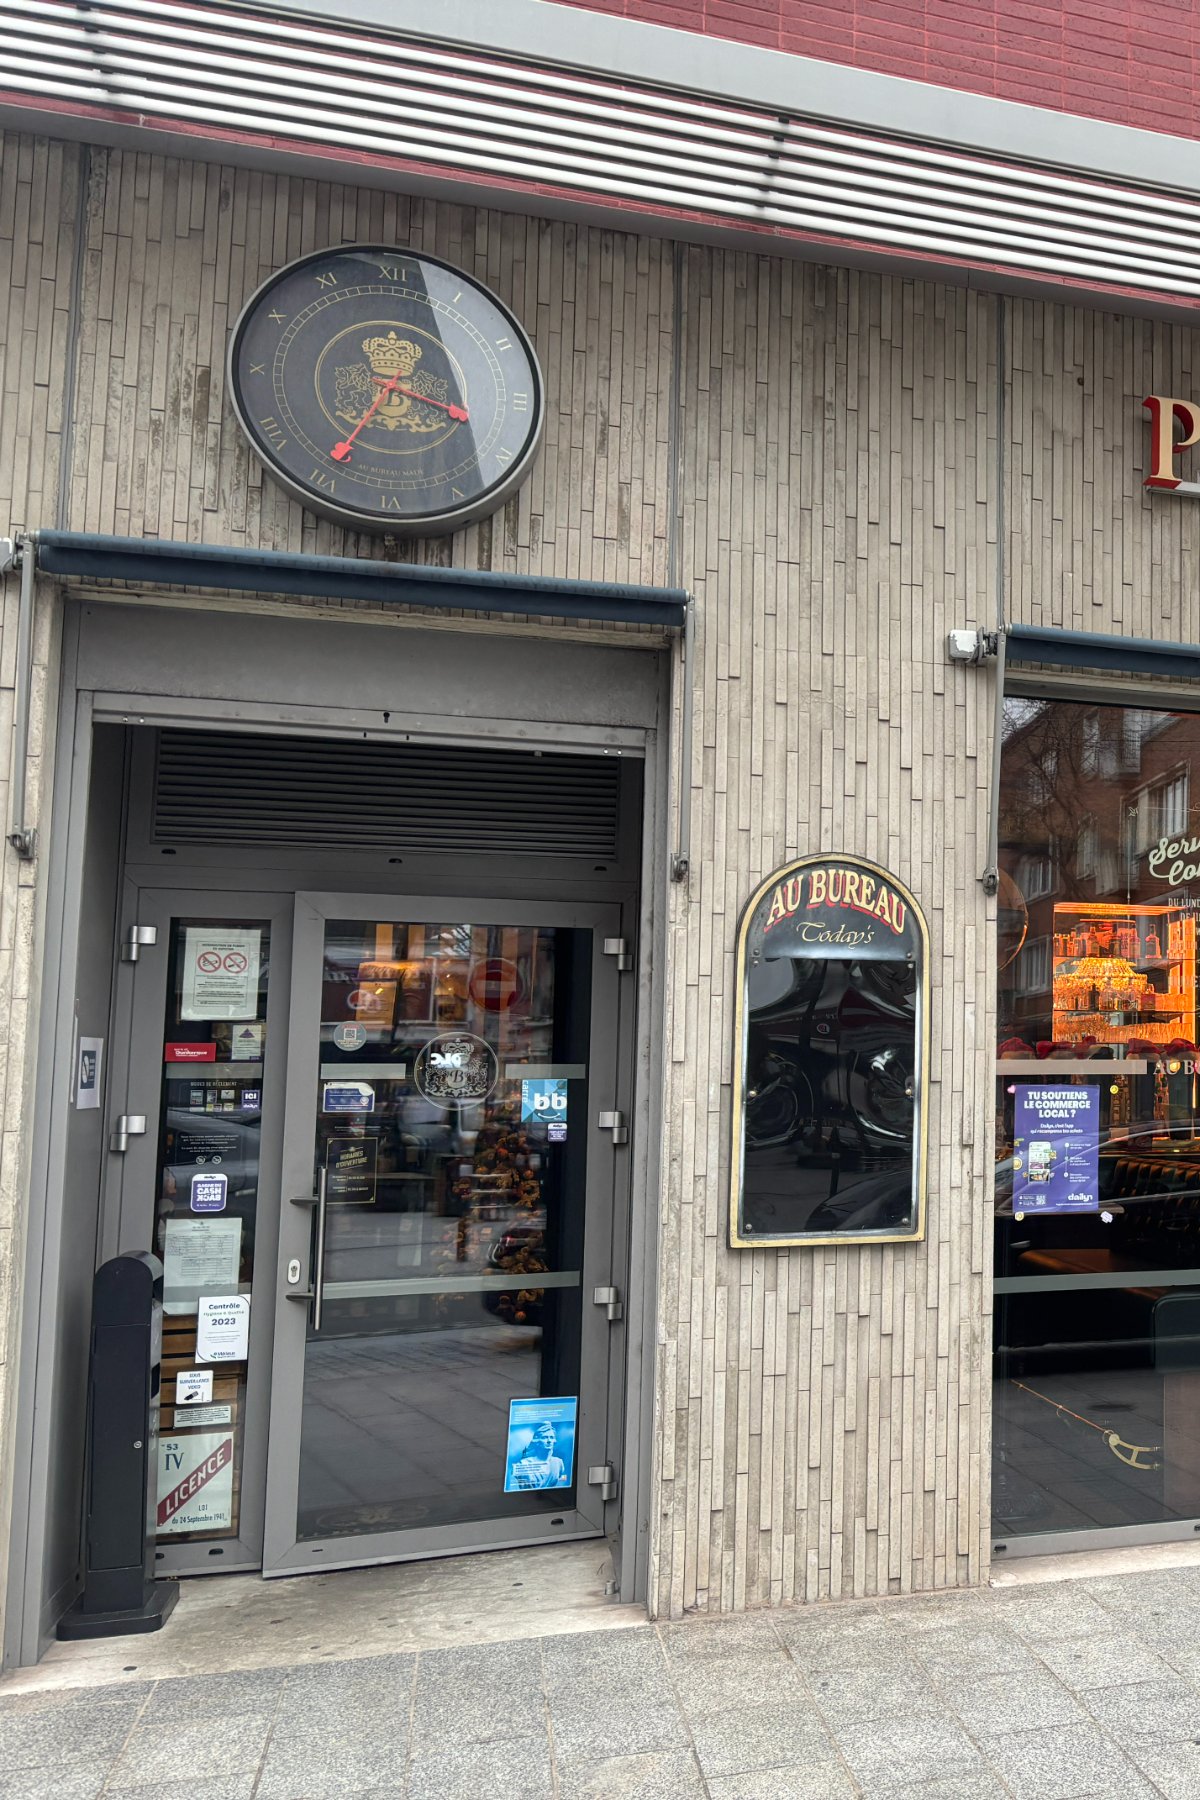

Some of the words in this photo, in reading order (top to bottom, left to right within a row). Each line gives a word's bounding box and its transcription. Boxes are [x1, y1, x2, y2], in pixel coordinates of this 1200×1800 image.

[315, 272, 338, 289] XI
[379, 266, 407, 281] XII
[268, 309, 287, 324] X
[496, 337, 513, 351] II
[308, 469, 338, 493] VII
[381, 495, 401, 509] VI
[763, 874, 804, 933] AU
[806, 868, 907, 935] BUREAU
[1168, 898, 1179, 908] DU
[796, 921, 875, 949] Today's
[1028, 1091, 1040, 1100] TU
[1041, 1091, 1088, 1100] SOUTIENS
[1024, 1100, 1034, 1109] LE
[1035, 1100, 1091, 1109] COMMERCE
[1039, 1109, 1070, 1118] LOCAL
[208, 1302, 241, 1310] Contrôle
[211, 1317, 236, 1326] 2023
[165, 1453, 184, 1471] IV
[166, 1447, 224, 1516] LICENCE
